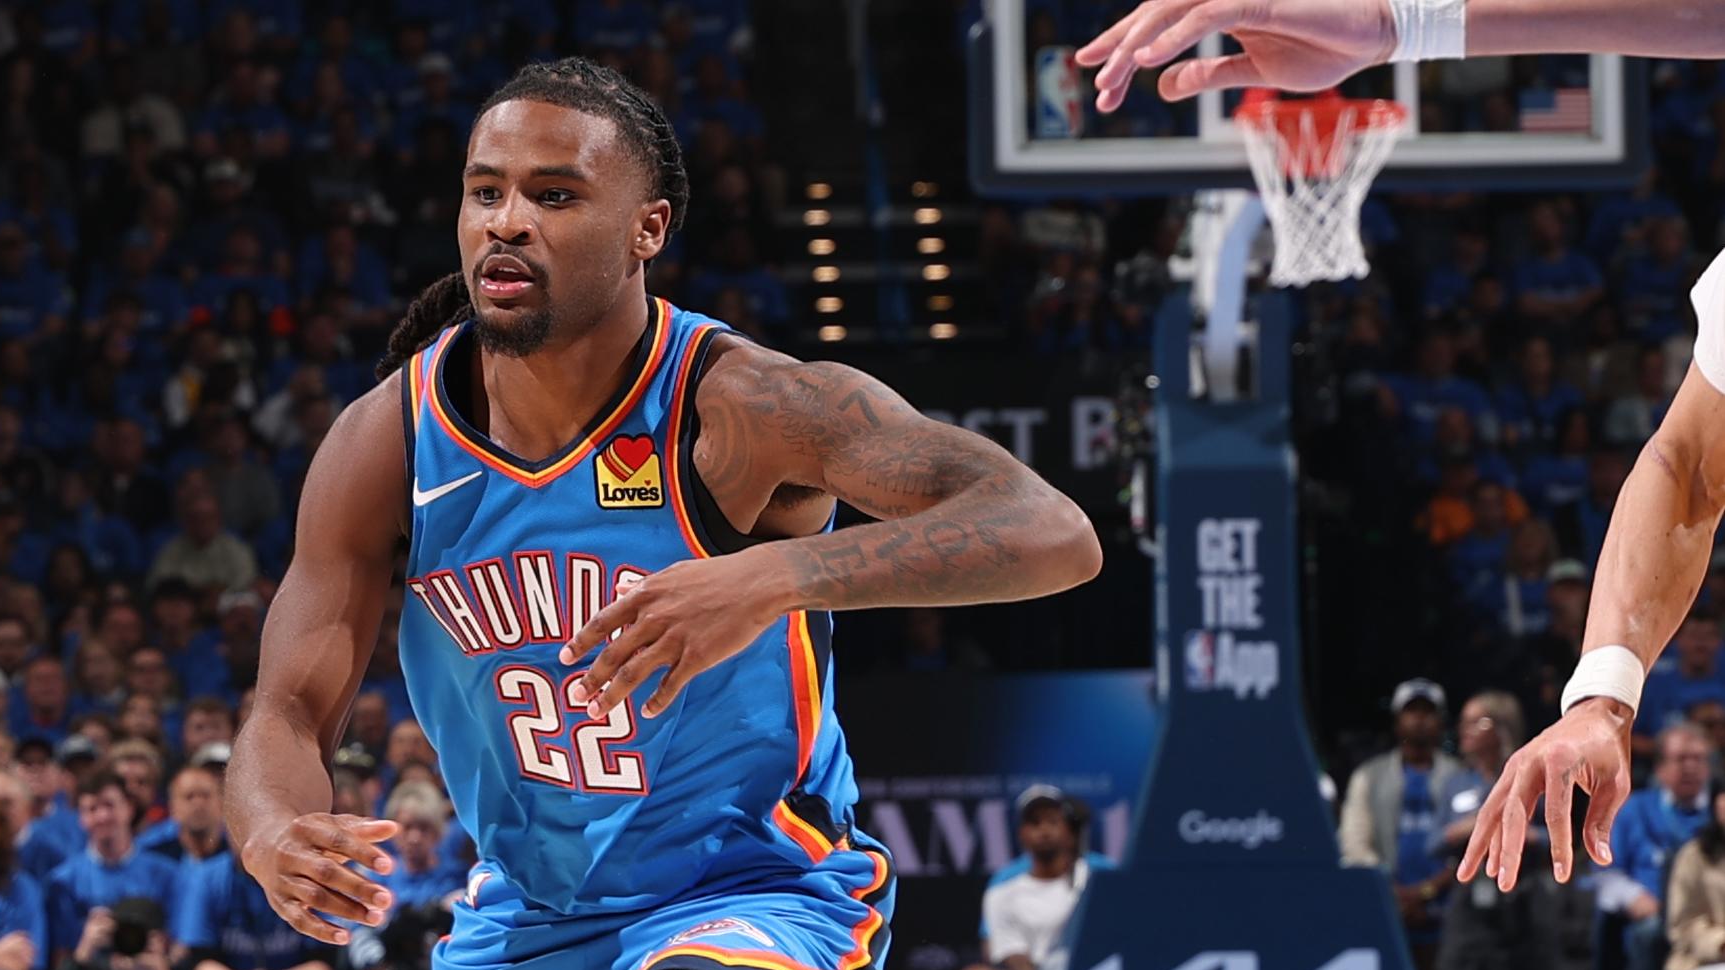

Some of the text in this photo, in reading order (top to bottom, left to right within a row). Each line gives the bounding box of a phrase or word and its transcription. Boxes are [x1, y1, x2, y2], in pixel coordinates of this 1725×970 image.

[1197, 518, 1261, 571] GET
[408, 551, 652, 656] THUND
[1197, 574, 1264, 629] THE
[1215, 631, 1280, 698] App
[494, 664, 650, 796] 22
[1176, 809, 1284, 849] Google
